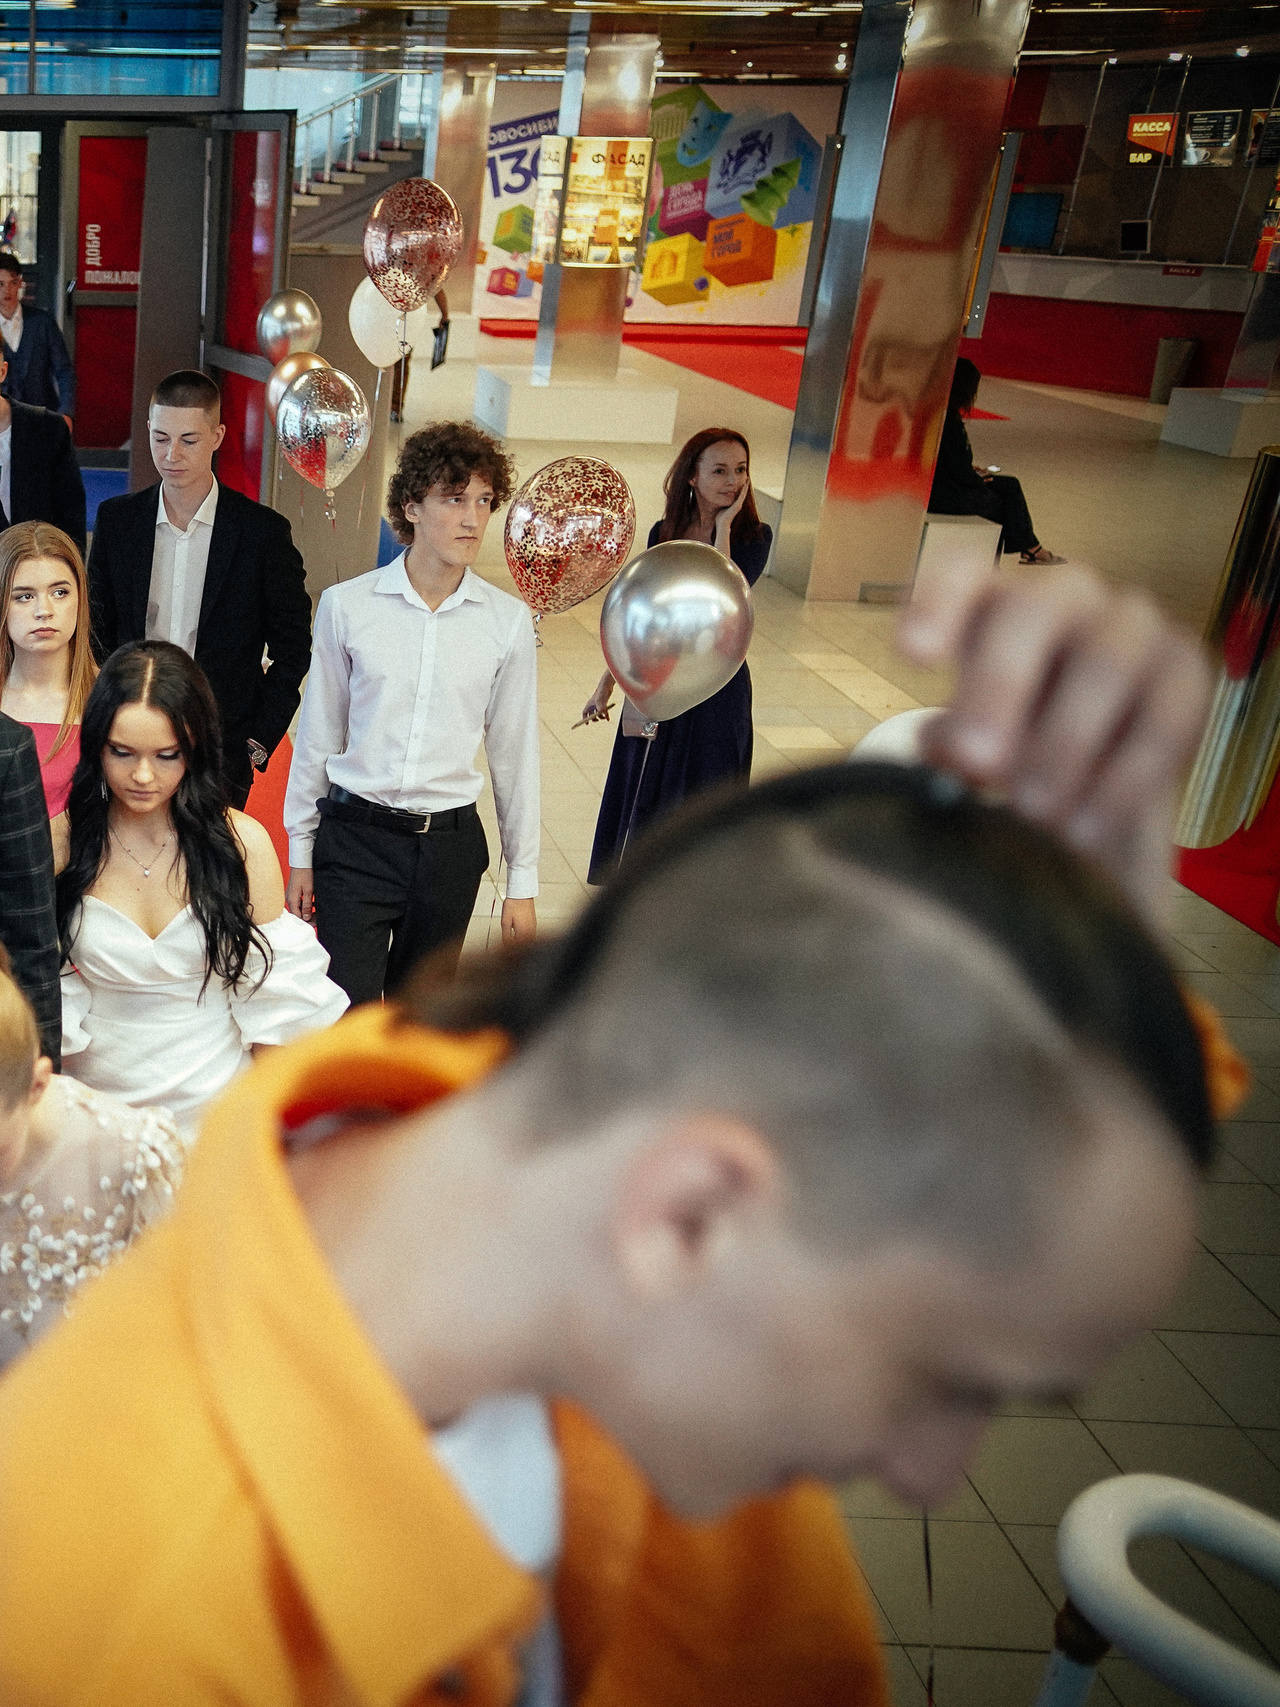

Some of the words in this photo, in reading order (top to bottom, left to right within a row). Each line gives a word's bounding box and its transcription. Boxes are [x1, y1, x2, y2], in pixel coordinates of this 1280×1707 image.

[1132, 122, 1171, 132] КАССА
[592, 152, 646, 167] ФАСАД
[1129, 152, 1153, 163] БАР
[85, 223, 102, 267] ДОБРО
